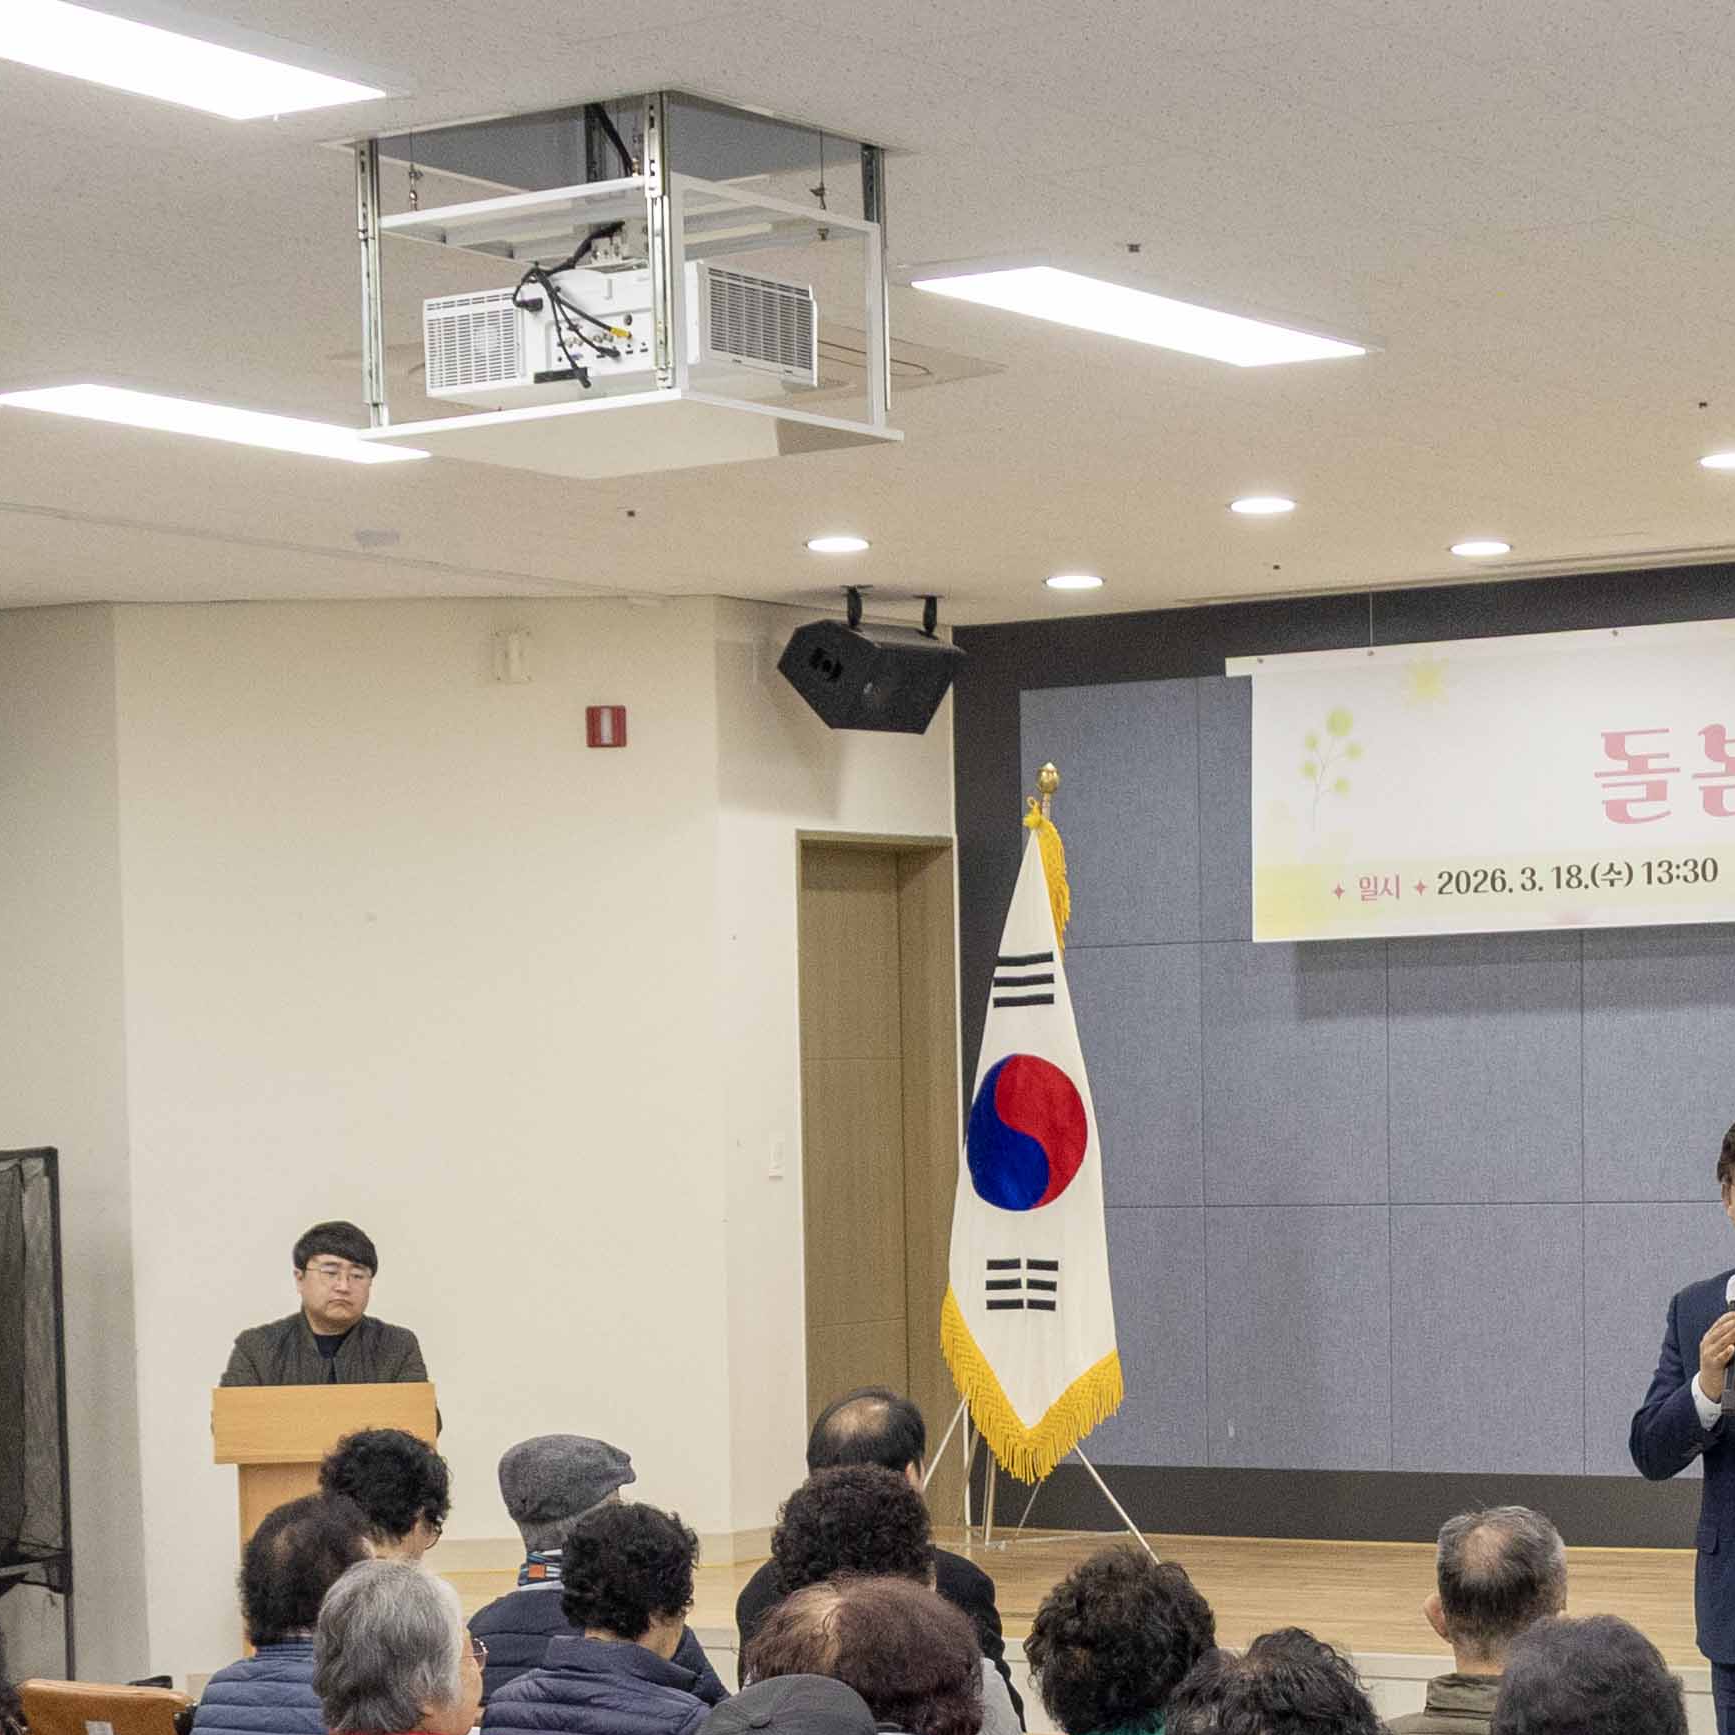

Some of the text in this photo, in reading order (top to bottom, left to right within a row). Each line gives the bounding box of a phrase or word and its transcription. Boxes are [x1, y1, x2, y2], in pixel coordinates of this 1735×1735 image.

[1358, 873, 1401, 902] 일시
[1437, 867, 1514, 896] 2026.
[1520, 866, 1544, 893] 3.
[1641, 857, 1719, 886] 13:30
